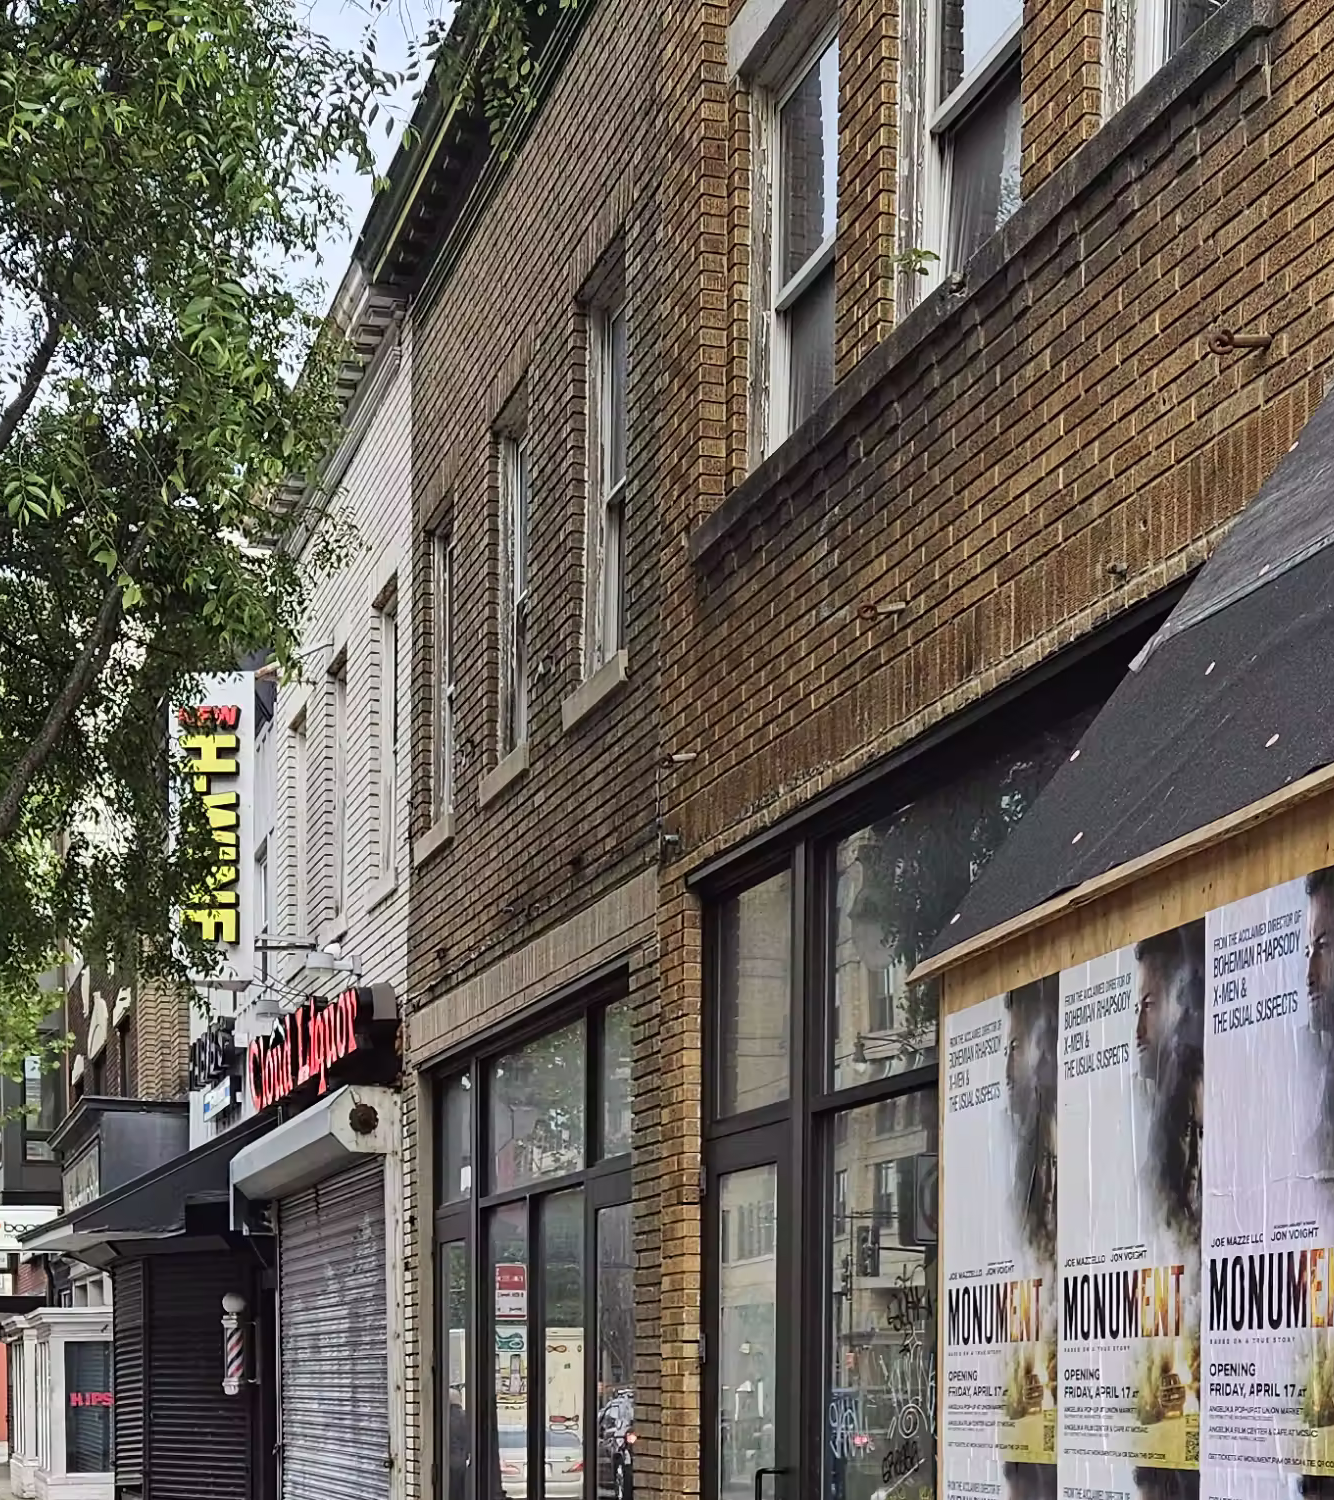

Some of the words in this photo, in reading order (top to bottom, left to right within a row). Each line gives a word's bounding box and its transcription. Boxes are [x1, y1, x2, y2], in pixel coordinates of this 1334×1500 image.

[249, 1013, 294, 1113] Cloud
[295, 987, 358, 1096] Liquor
[948, 1278, 1043, 1346] MONUMENT
[1063, 1265, 1185, 1341] MONUMENT
[948, 1370, 978, 1382] OPENING
[1064, 1368, 1100, 1381] OPENING
[1209, 1362, 1256, 1377] OPENING
